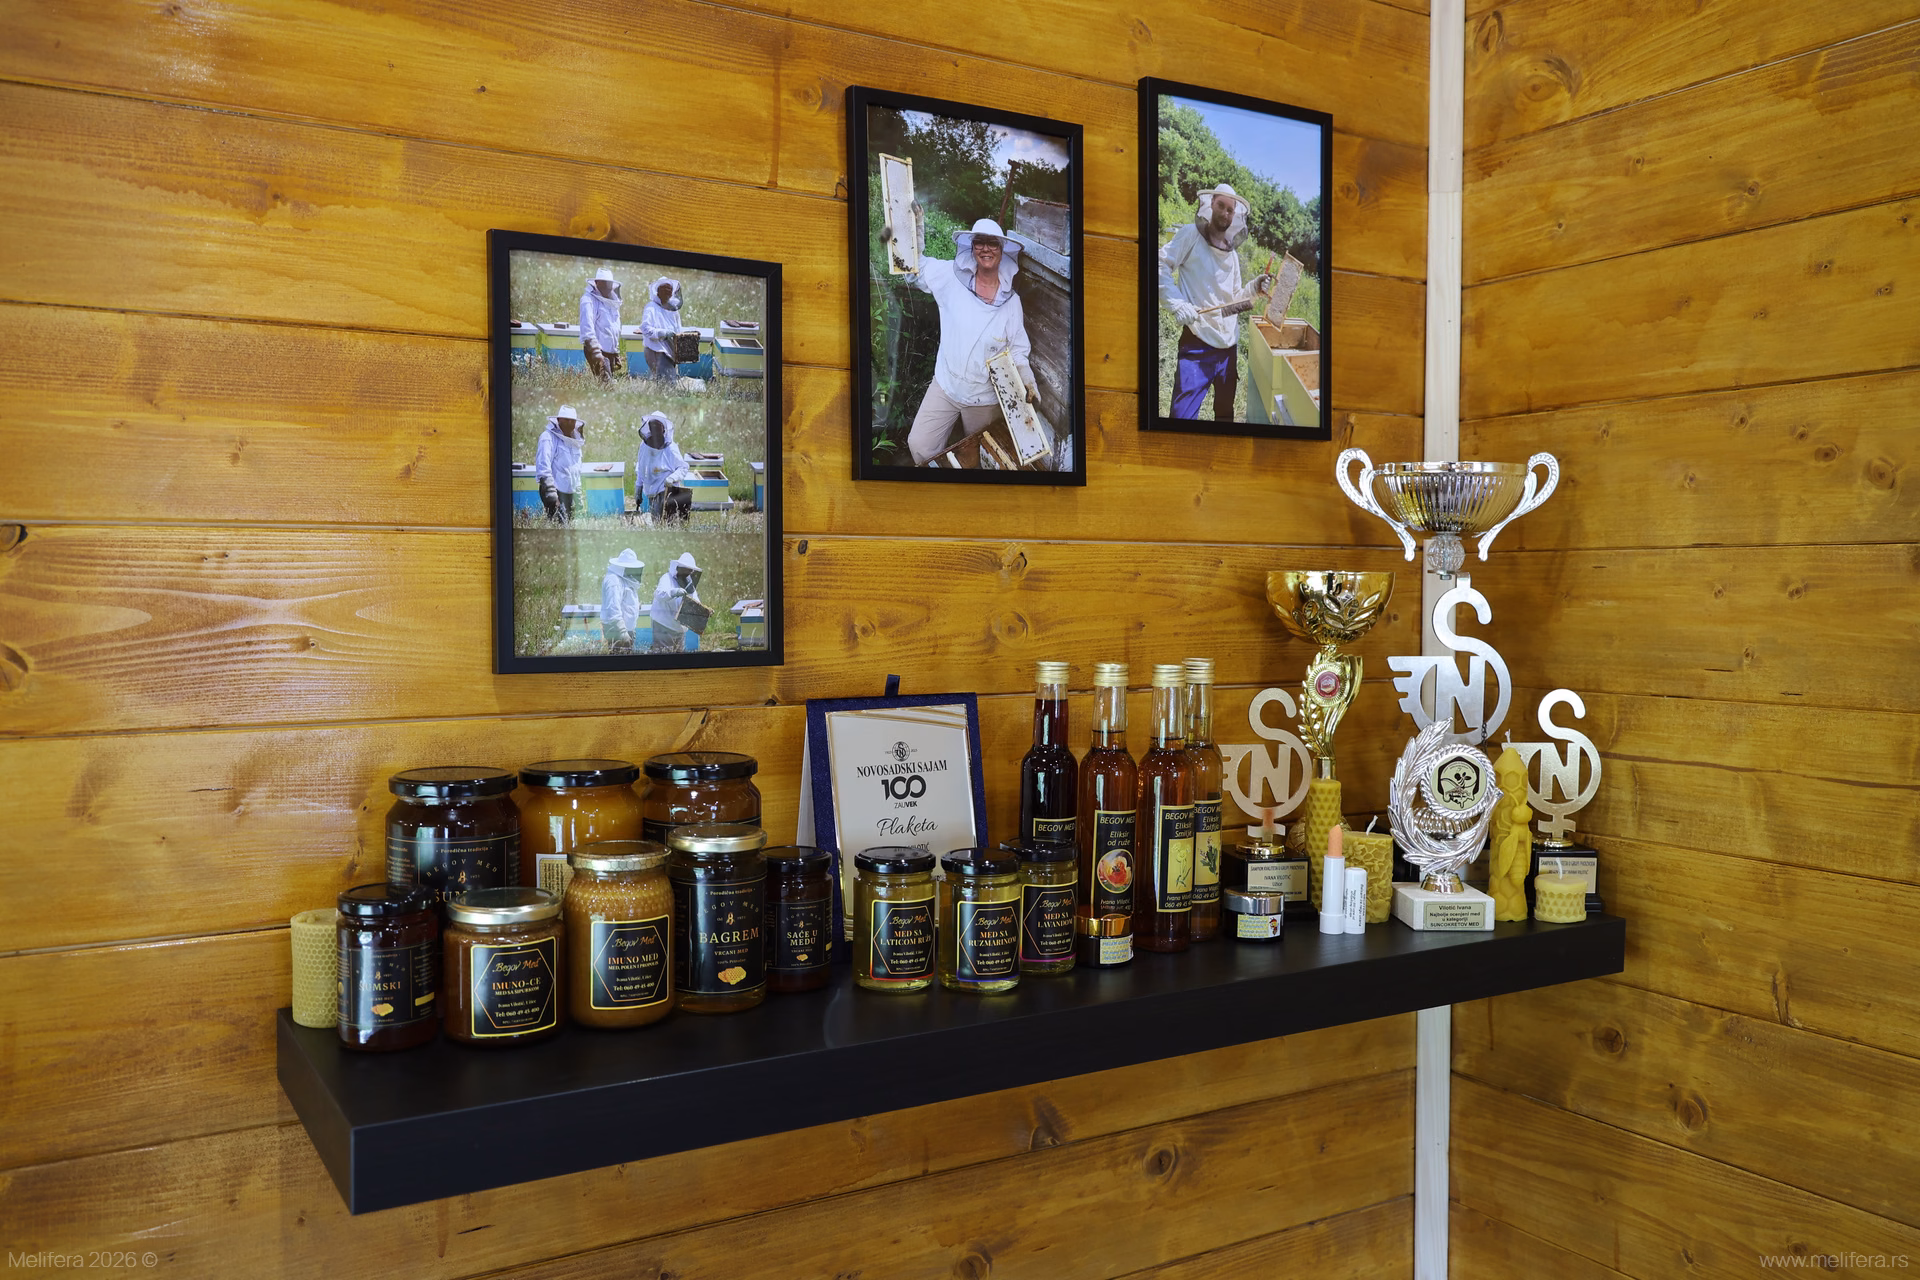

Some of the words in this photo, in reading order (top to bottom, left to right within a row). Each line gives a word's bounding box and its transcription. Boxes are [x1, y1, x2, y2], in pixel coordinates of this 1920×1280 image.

[856, 762, 916, 778] NOVOSADSKI
[917, 760, 947, 773] SAJAM
[881, 775, 926, 800] 100
[1100, 816, 1124, 824] BEGOV
[1165, 812, 1188, 820] BEGOV
[876, 815, 938, 836] Plaketa
[1175, 822, 1192, 830] Eliksir
[426, 859, 466, 877] BEGOV
[477, 859, 497, 872] MED
[1039, 899, 1061, 911] Begov
[889, 916, 913, 928] Begov
[914, 913, 928, 923] Med
[975, 916, 999, 929] Begov
[1000, 914, 1014, 924] Med
[1038, 919, 1073, 927] LAVANDOM
[700, 927, 759, 943] BAGREM
[790, 937, 816, 946] MEDU
[968, 936, 1016, 946] RUZMARINOM
[611, 937, 639, 951] Begov
[640, 934, 657, 945] Med
[880, 938, 916, 946] LATICOM
[608, 956, 639, 964] IMUNO
[641, 953, 659, 962] MED
[492, 961, 521, 976] Begov
[522, 958, 541, 969] Med
[492, 977, 541, 990] IMUNO-CE
